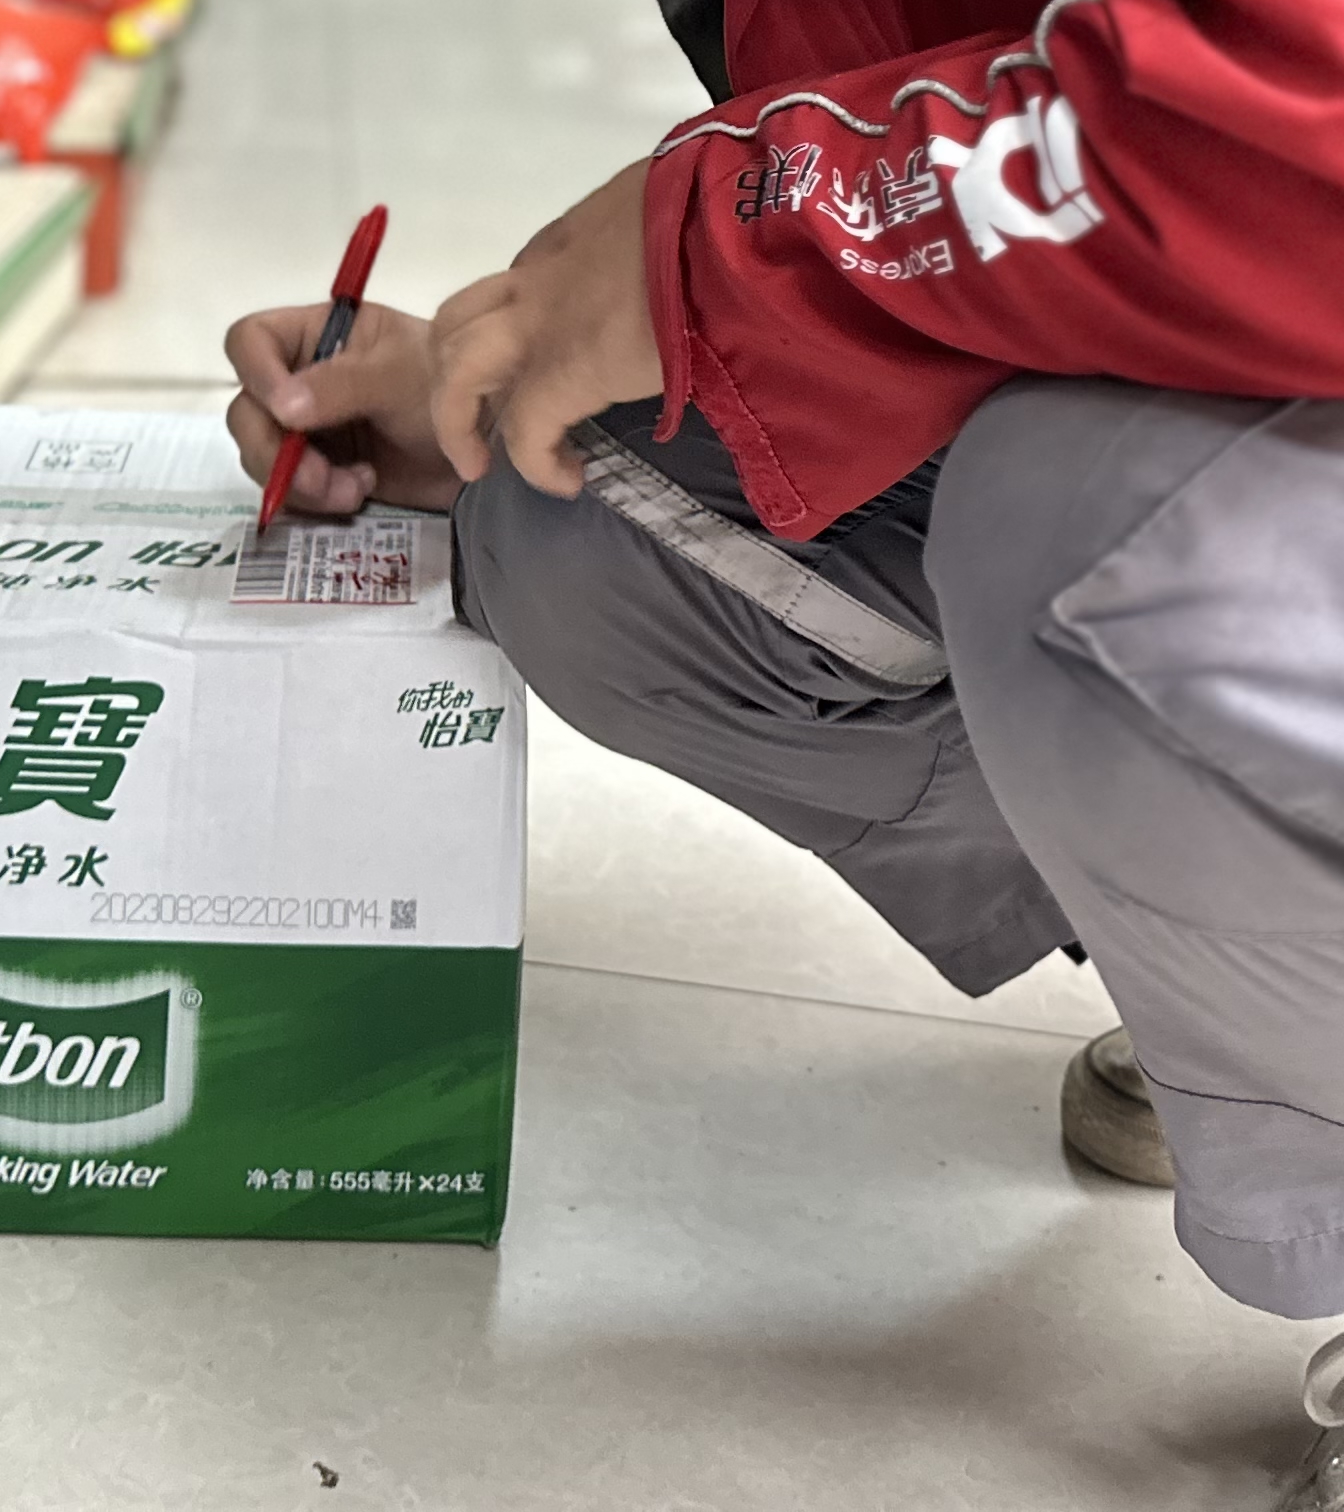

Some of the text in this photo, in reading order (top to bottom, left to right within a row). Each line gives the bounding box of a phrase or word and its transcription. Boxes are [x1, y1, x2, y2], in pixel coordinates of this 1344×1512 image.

[839, 239, 954, 280] Express
[129, 540, 240, 568] 怡
[397, 680, 475, 714] 你我的
[419, 706, 505, 749] 怡寶
[68, 1158, 168, 1189] Water
